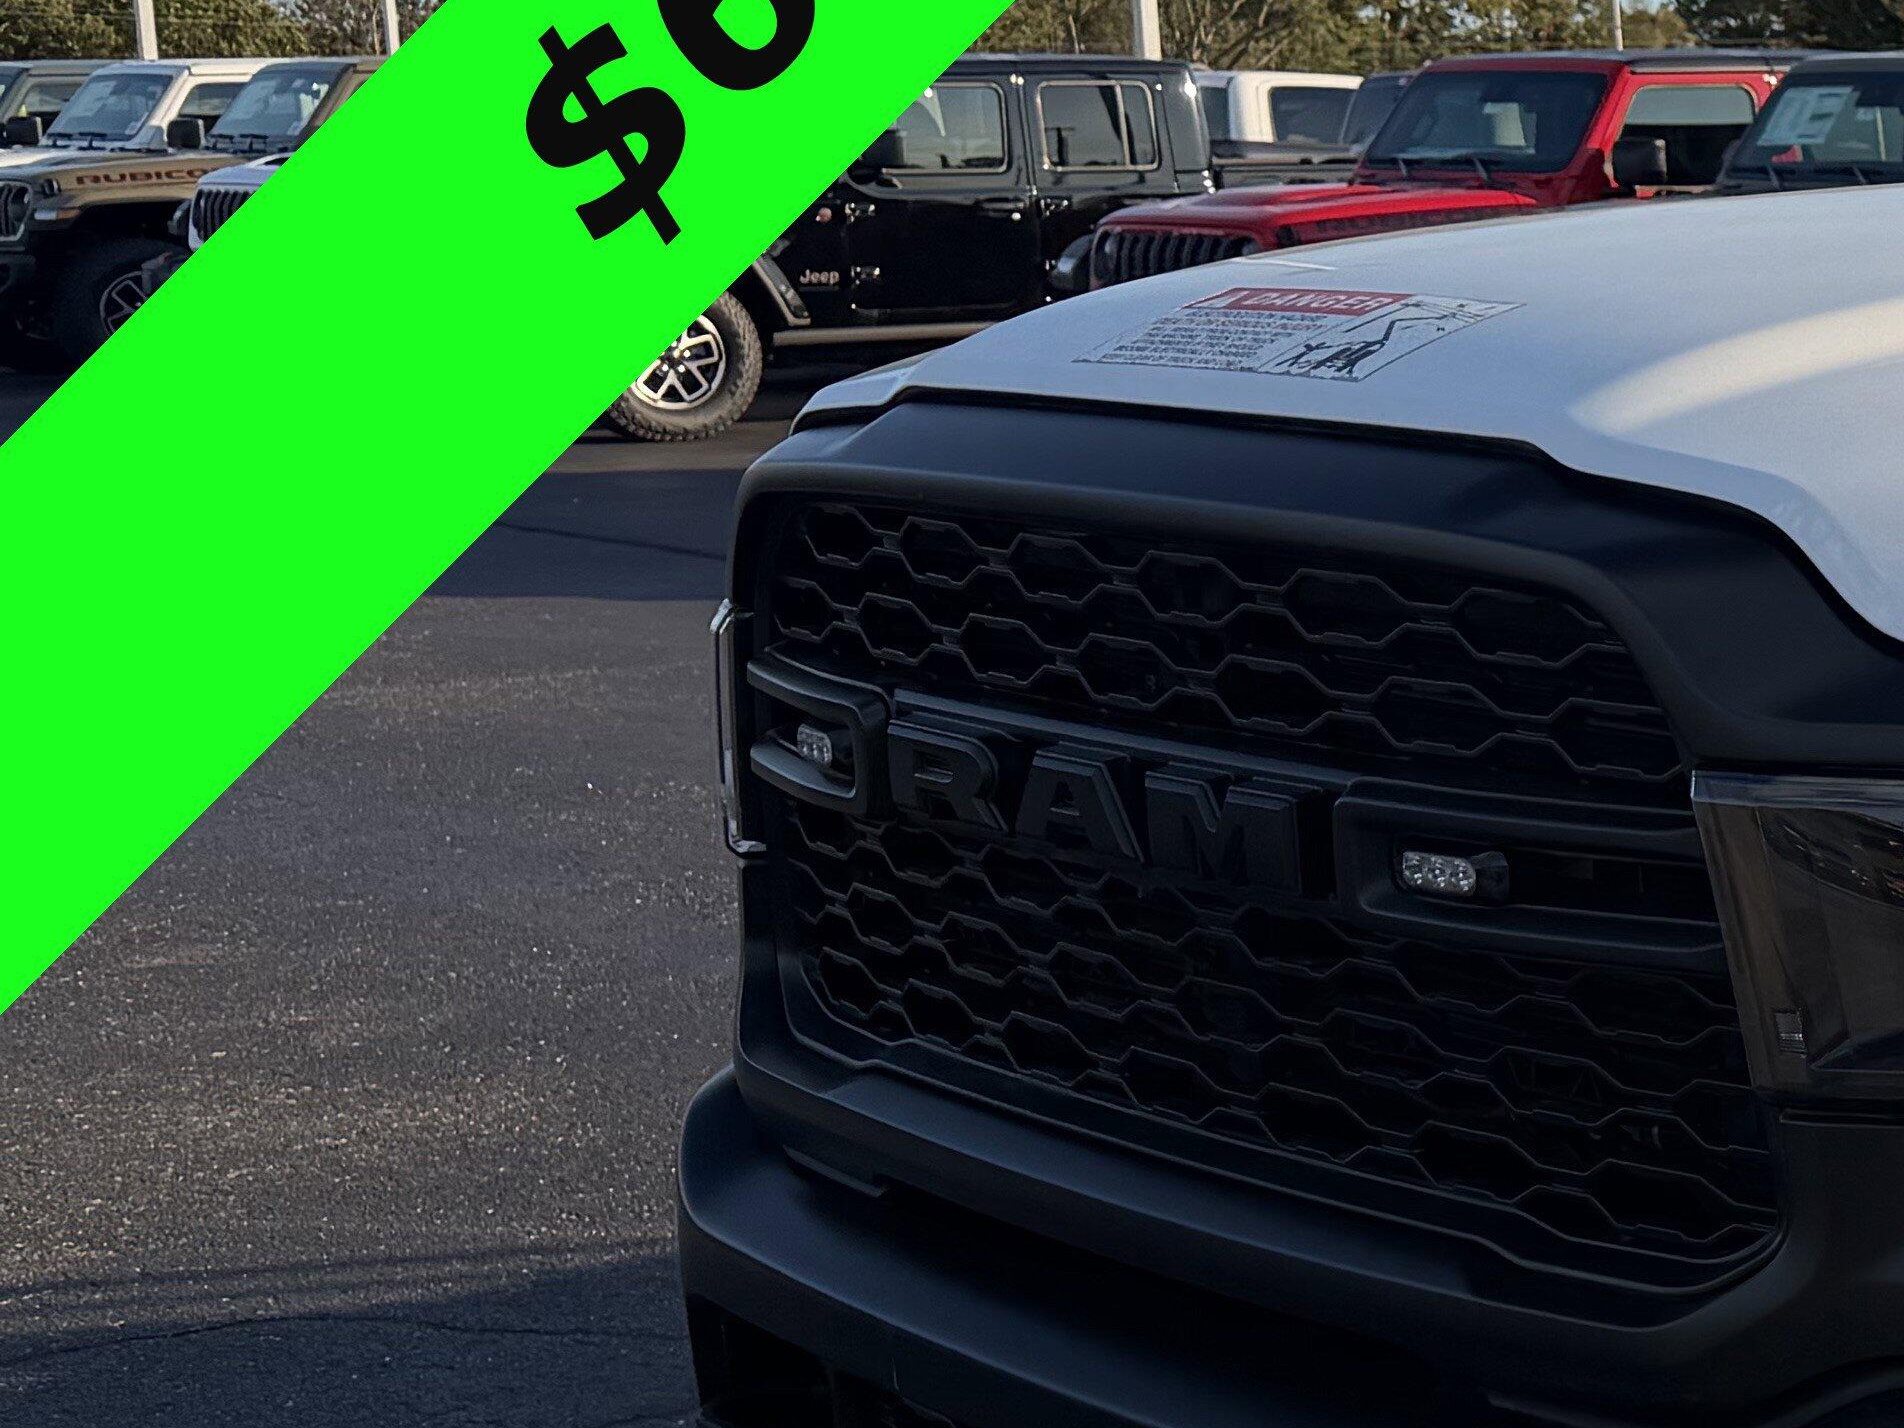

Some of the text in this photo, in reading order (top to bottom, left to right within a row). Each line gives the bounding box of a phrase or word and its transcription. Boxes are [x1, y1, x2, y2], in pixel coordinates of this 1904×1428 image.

[76, 168, 222, 185] RUBICO
[799, 269, 840, 285] Jeep
[1242, 291, 1395, 310] DANGER
[887, 713, 1314, 891] RAM
